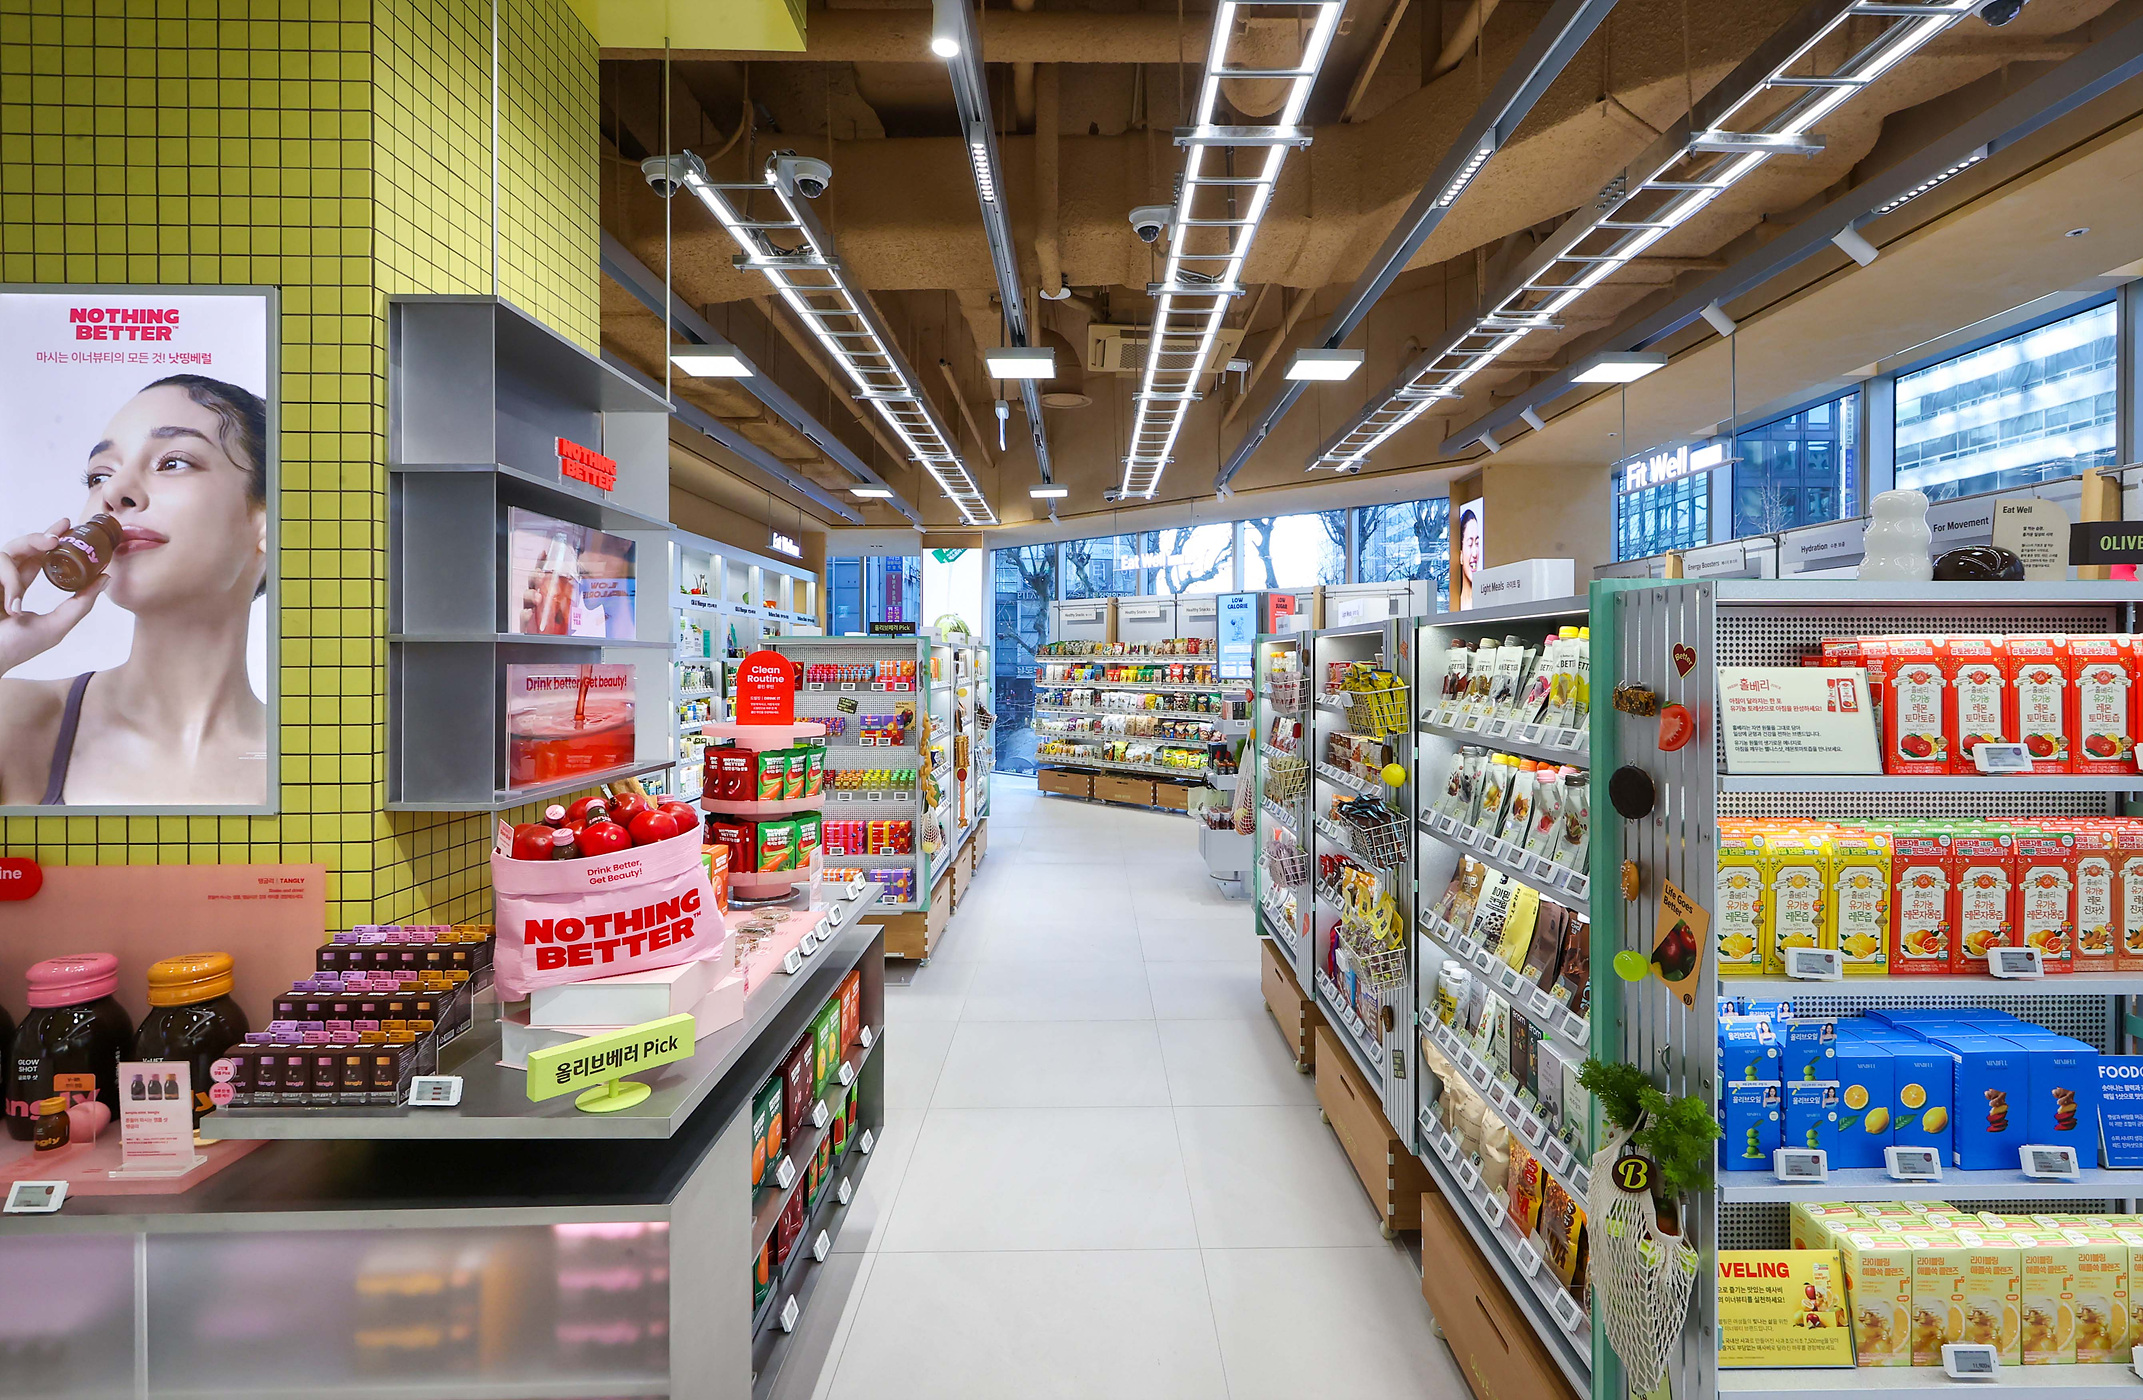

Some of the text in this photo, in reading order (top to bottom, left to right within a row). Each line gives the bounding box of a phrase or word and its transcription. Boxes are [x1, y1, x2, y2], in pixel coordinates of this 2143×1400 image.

[69, 307, 180, 324] NOTHING
[75, 325, 173, 341] BETTER
[36, 351, 213, 365] 마시는 이너뷰티의 모든 것! 낫띵베럴
[558, 438, 617, 476] NOTHING
[1626, 446, 1688, 490] Fit Well
[562, 458, 614, 492] BETTER
[2002, 505, 2033, 514] Eat Well
[1932, 516, 1989, 533] For Movement
[1801, 543, 1828, 554] Hydration
[1121, 552, 1165, 569] Eat Well
[1687, 563, 1701, 572] Energy
[1701, 561, 1720, 570] Boosters
[1480, 581, 1505, 595] Light Meals
[1675, 652, 1693, 667] Better
[751, 666, 780, 674] Clean
[526, 675, 627, 692] Drink Get beauty!
[747, 674, 785, 683] Routine
[1740, 678, 1770, 692] 홀베리
[1910, 694, 1930, 704] 유기농
[1970, 694, 1990, 704] 유기농
[2031, 694, 2051, 704] 유기농
[2094, 694, 2114, 704] 유기농
[1912, 704, 1928, 713] 레몬
[1972, 704, 1987, 713] 레몬
[2034, 704, 2048, 713] 레몬
[2096, 704, 2112, 713] 레몬
[1905, 714, 1936, 723] 토마토즙
[1966, 714, 1995, 723] 토마토즙
[2027, 714, 2056, 723] 토마토즙
[2088, 714, 2120, 723] 토마토즙
[587, 860, 643, 876] Drink Better,
[590, 868, 643, 885] Get Beauty!
[2085, 887, 2104, 895] 유기농
[1665, 884, 1694, 914] Life Goes
[1912, 900, 1934, 909] 유기농
[1973, 900, 1996, 909] 유기농
[2035, 900, 2057, 909] 유기농
[2088, 896, 2101, 905] 레몬
[1663, 896, 1683, 918] Better
[1726, 900, 1749, 910] 유기농
[1786, 900, 1810, 910] 유기농
[1849, 900, 1872, 910] 유기농
[524, 888, 701, 945] NOTHING
[1726, 911, 1750, 922] 레몬즙
[1786, 911, 1809, 922] 레몬즙
[1848, 911, 1872, 922] 레몬즙
[1904, 910, 1942, 920] 레몬자몽즙
[1964, 910, 2003, 920] 레몬자몽즙
[2026, 910, 2065, 920] 레몬자몽즙
[536, 916, 696, 971] BETTER
[1512, 1010, 1526, 1026] erom
[1529, 1024, 1542, 1039] erom
[555, 1034, 679, 1084] 올리브베러 Pick
[1618, 1158, 1648, 1189] B
